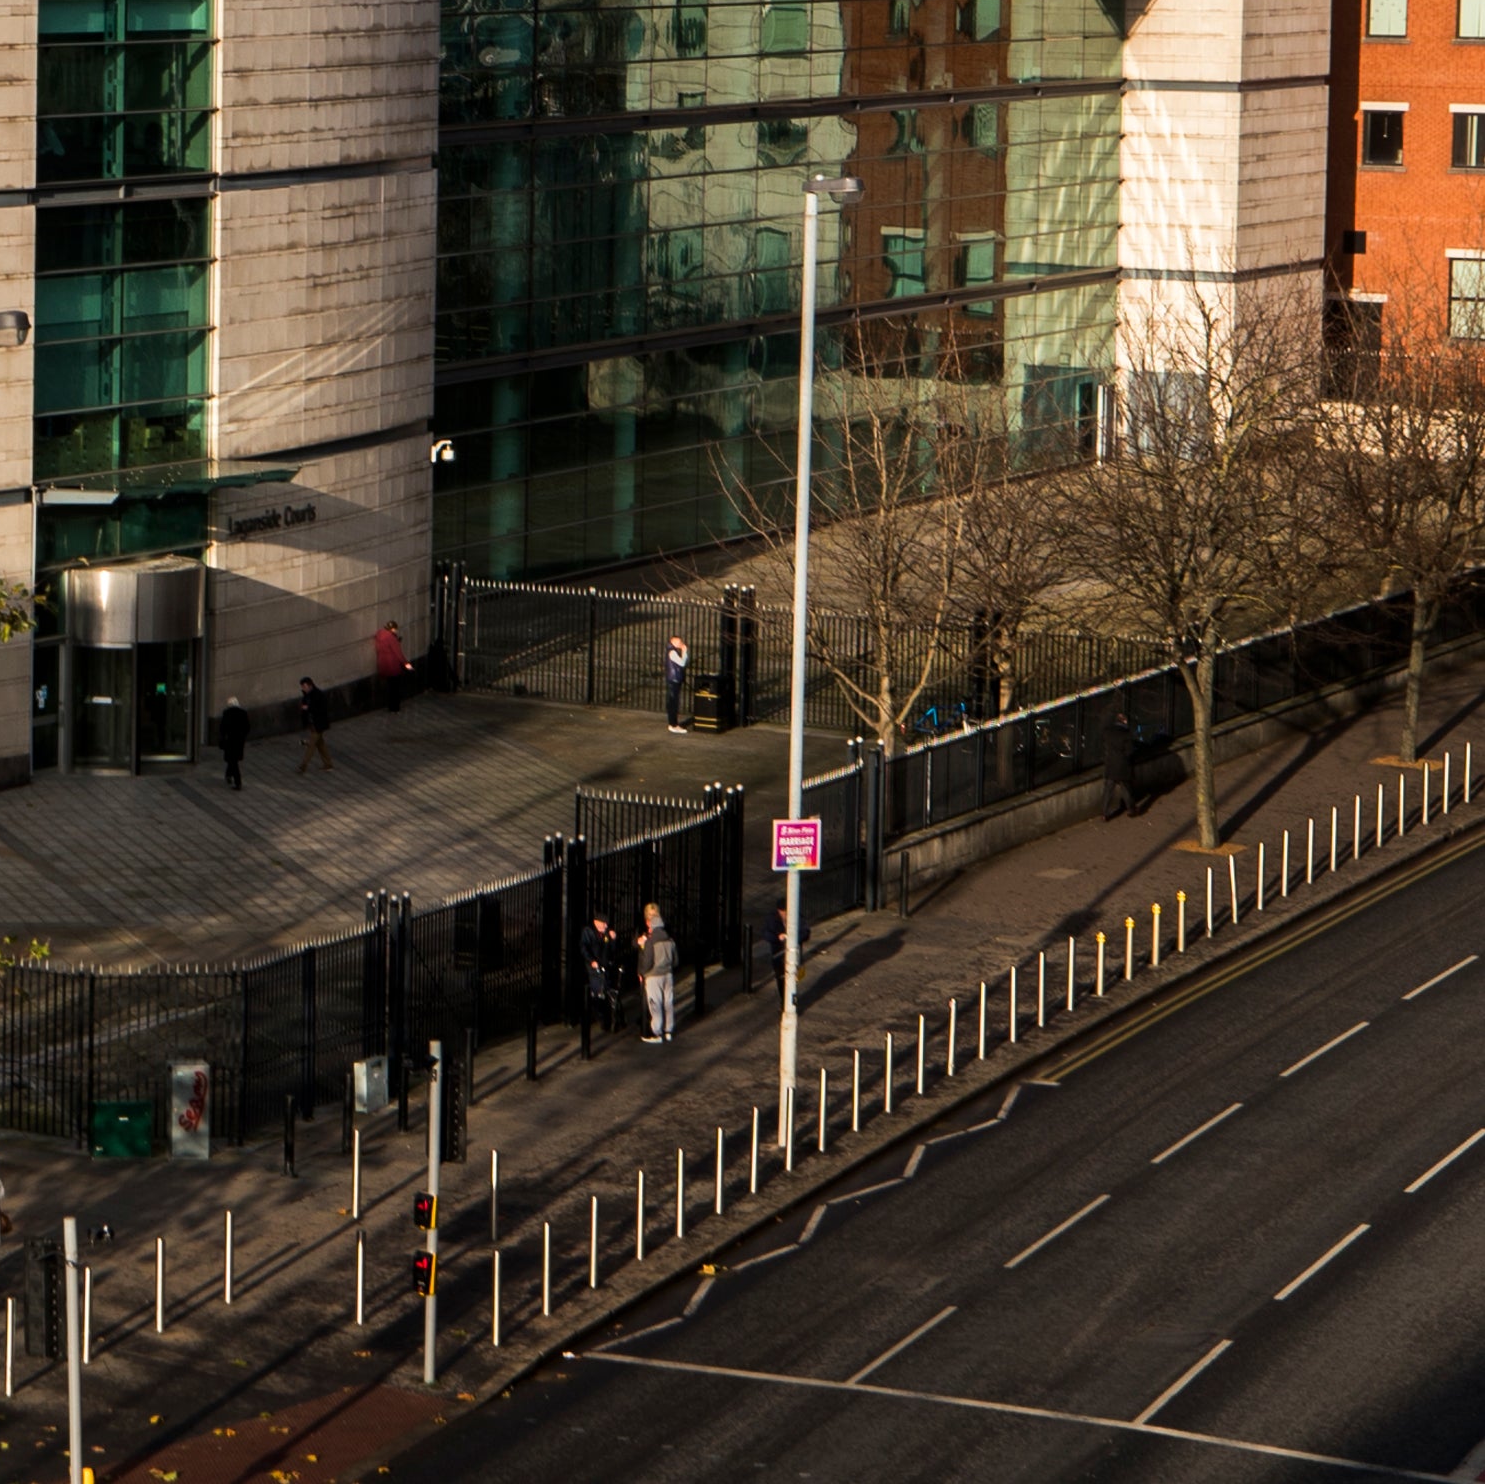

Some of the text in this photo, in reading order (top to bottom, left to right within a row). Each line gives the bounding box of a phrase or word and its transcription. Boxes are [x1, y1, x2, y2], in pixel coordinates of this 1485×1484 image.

[228, 503, 317, 541] Laganside Courts
[779, 836, 814, 846] MARRIAGE
[780, 846, 812, 856] EQUALITY
